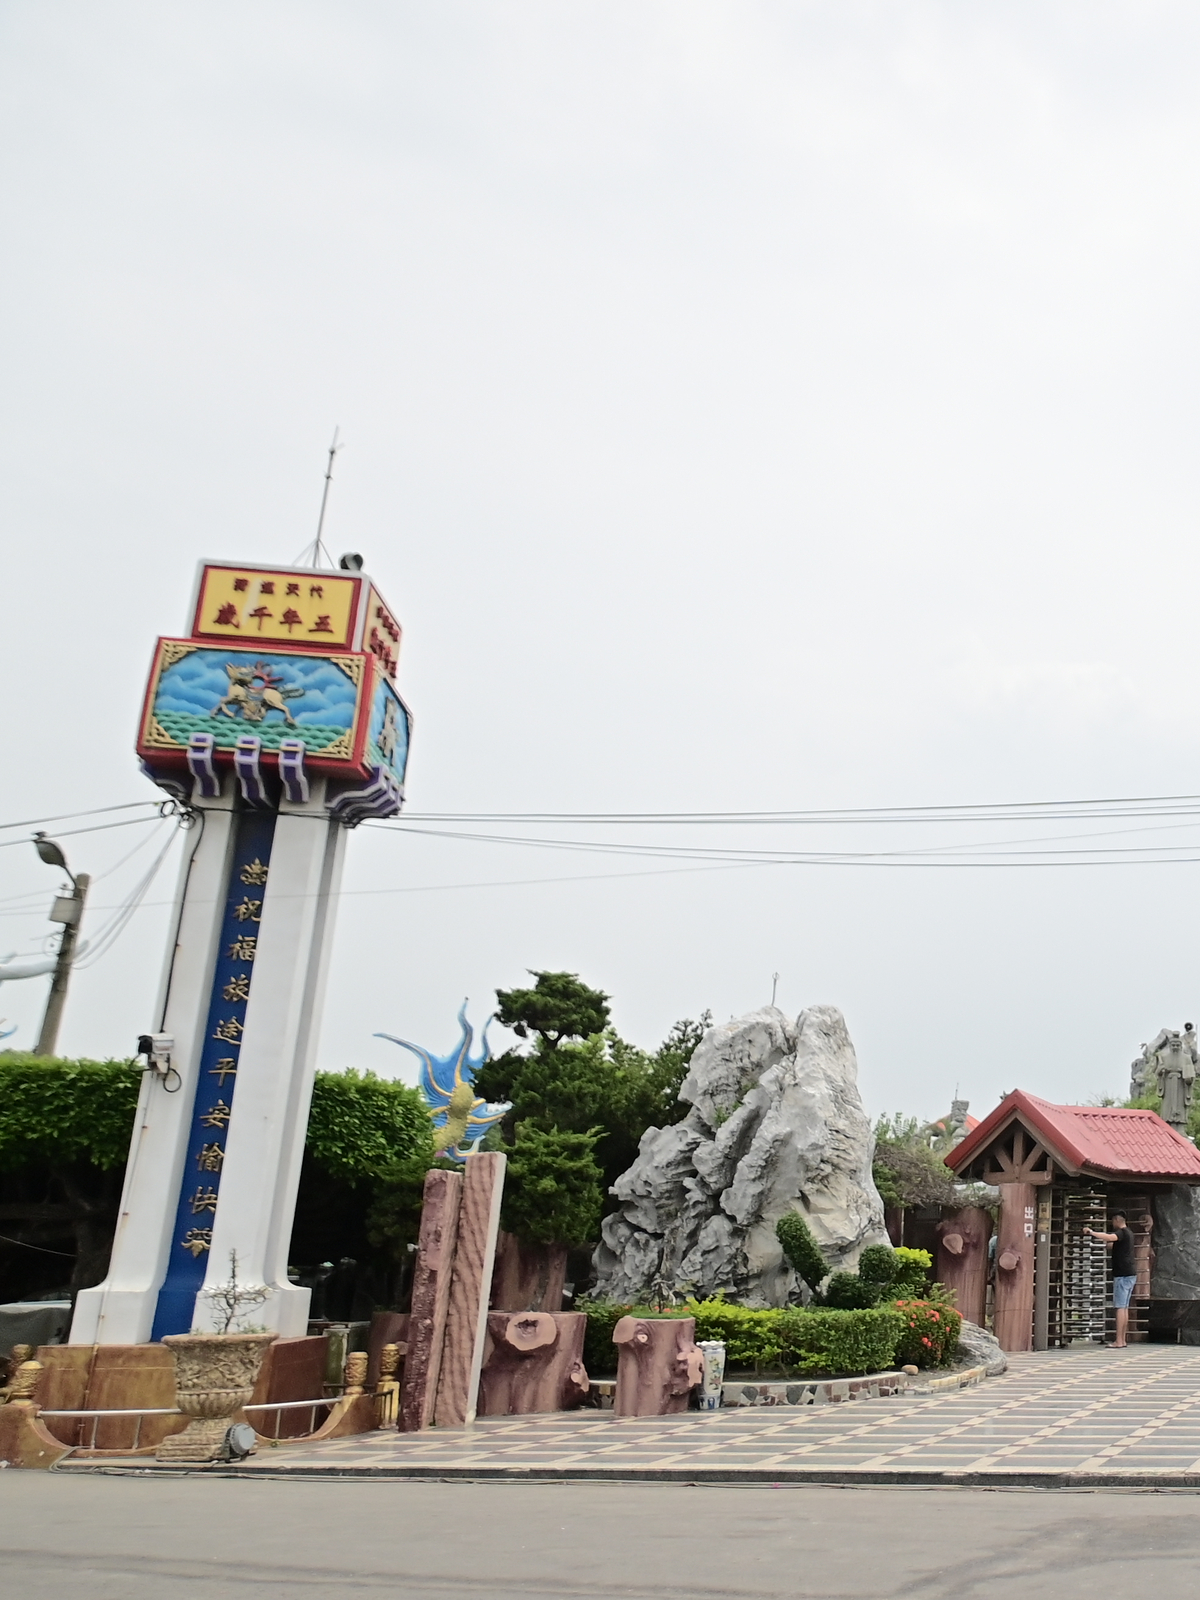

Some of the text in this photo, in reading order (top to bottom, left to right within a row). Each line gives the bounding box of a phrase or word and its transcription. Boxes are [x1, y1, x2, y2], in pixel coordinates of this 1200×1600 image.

[188, 896, 262, 1215] 祝福旅途平安愉快
[1024, 1206, 1034, 1233] 出口
